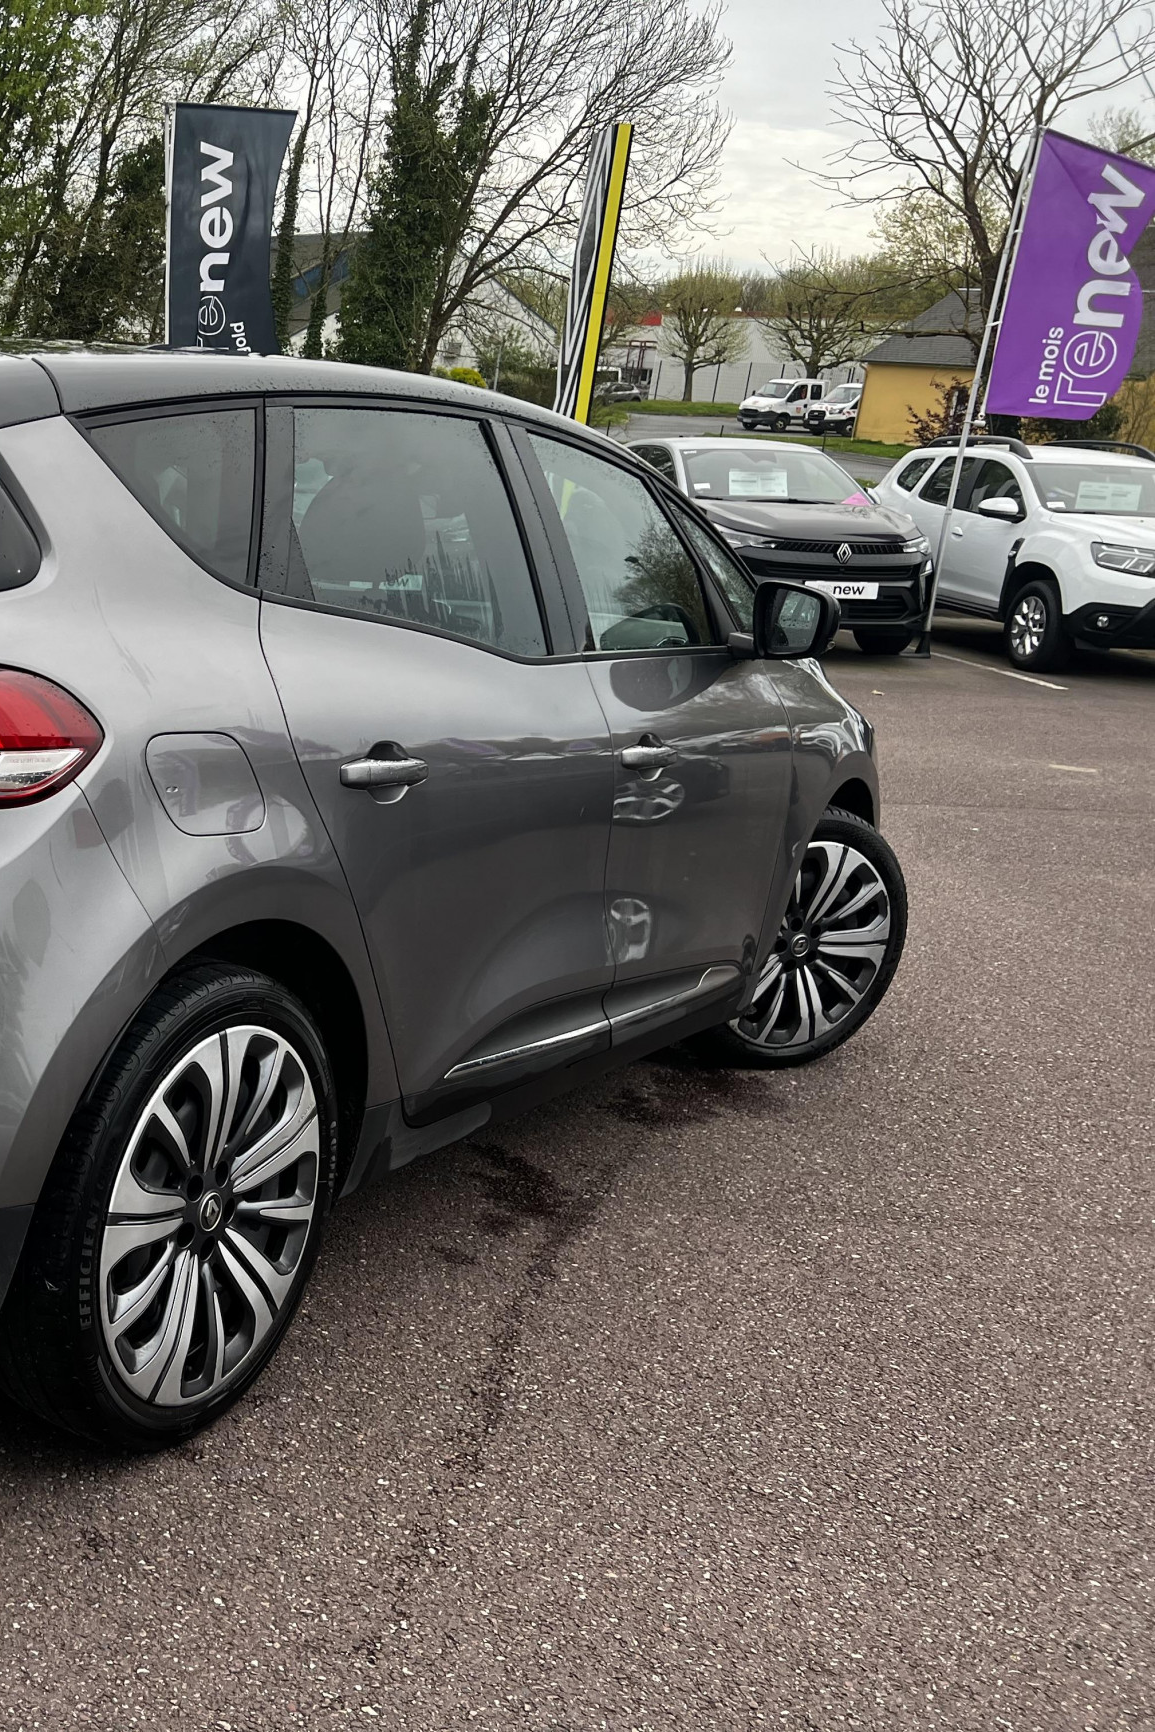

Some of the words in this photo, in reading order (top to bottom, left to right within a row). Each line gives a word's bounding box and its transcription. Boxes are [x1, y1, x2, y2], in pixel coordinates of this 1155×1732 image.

[1028, 384, 1050, 404] le
[1039, 326, 1064, 381] mois
[1053, 163, 1146, 408] renew
